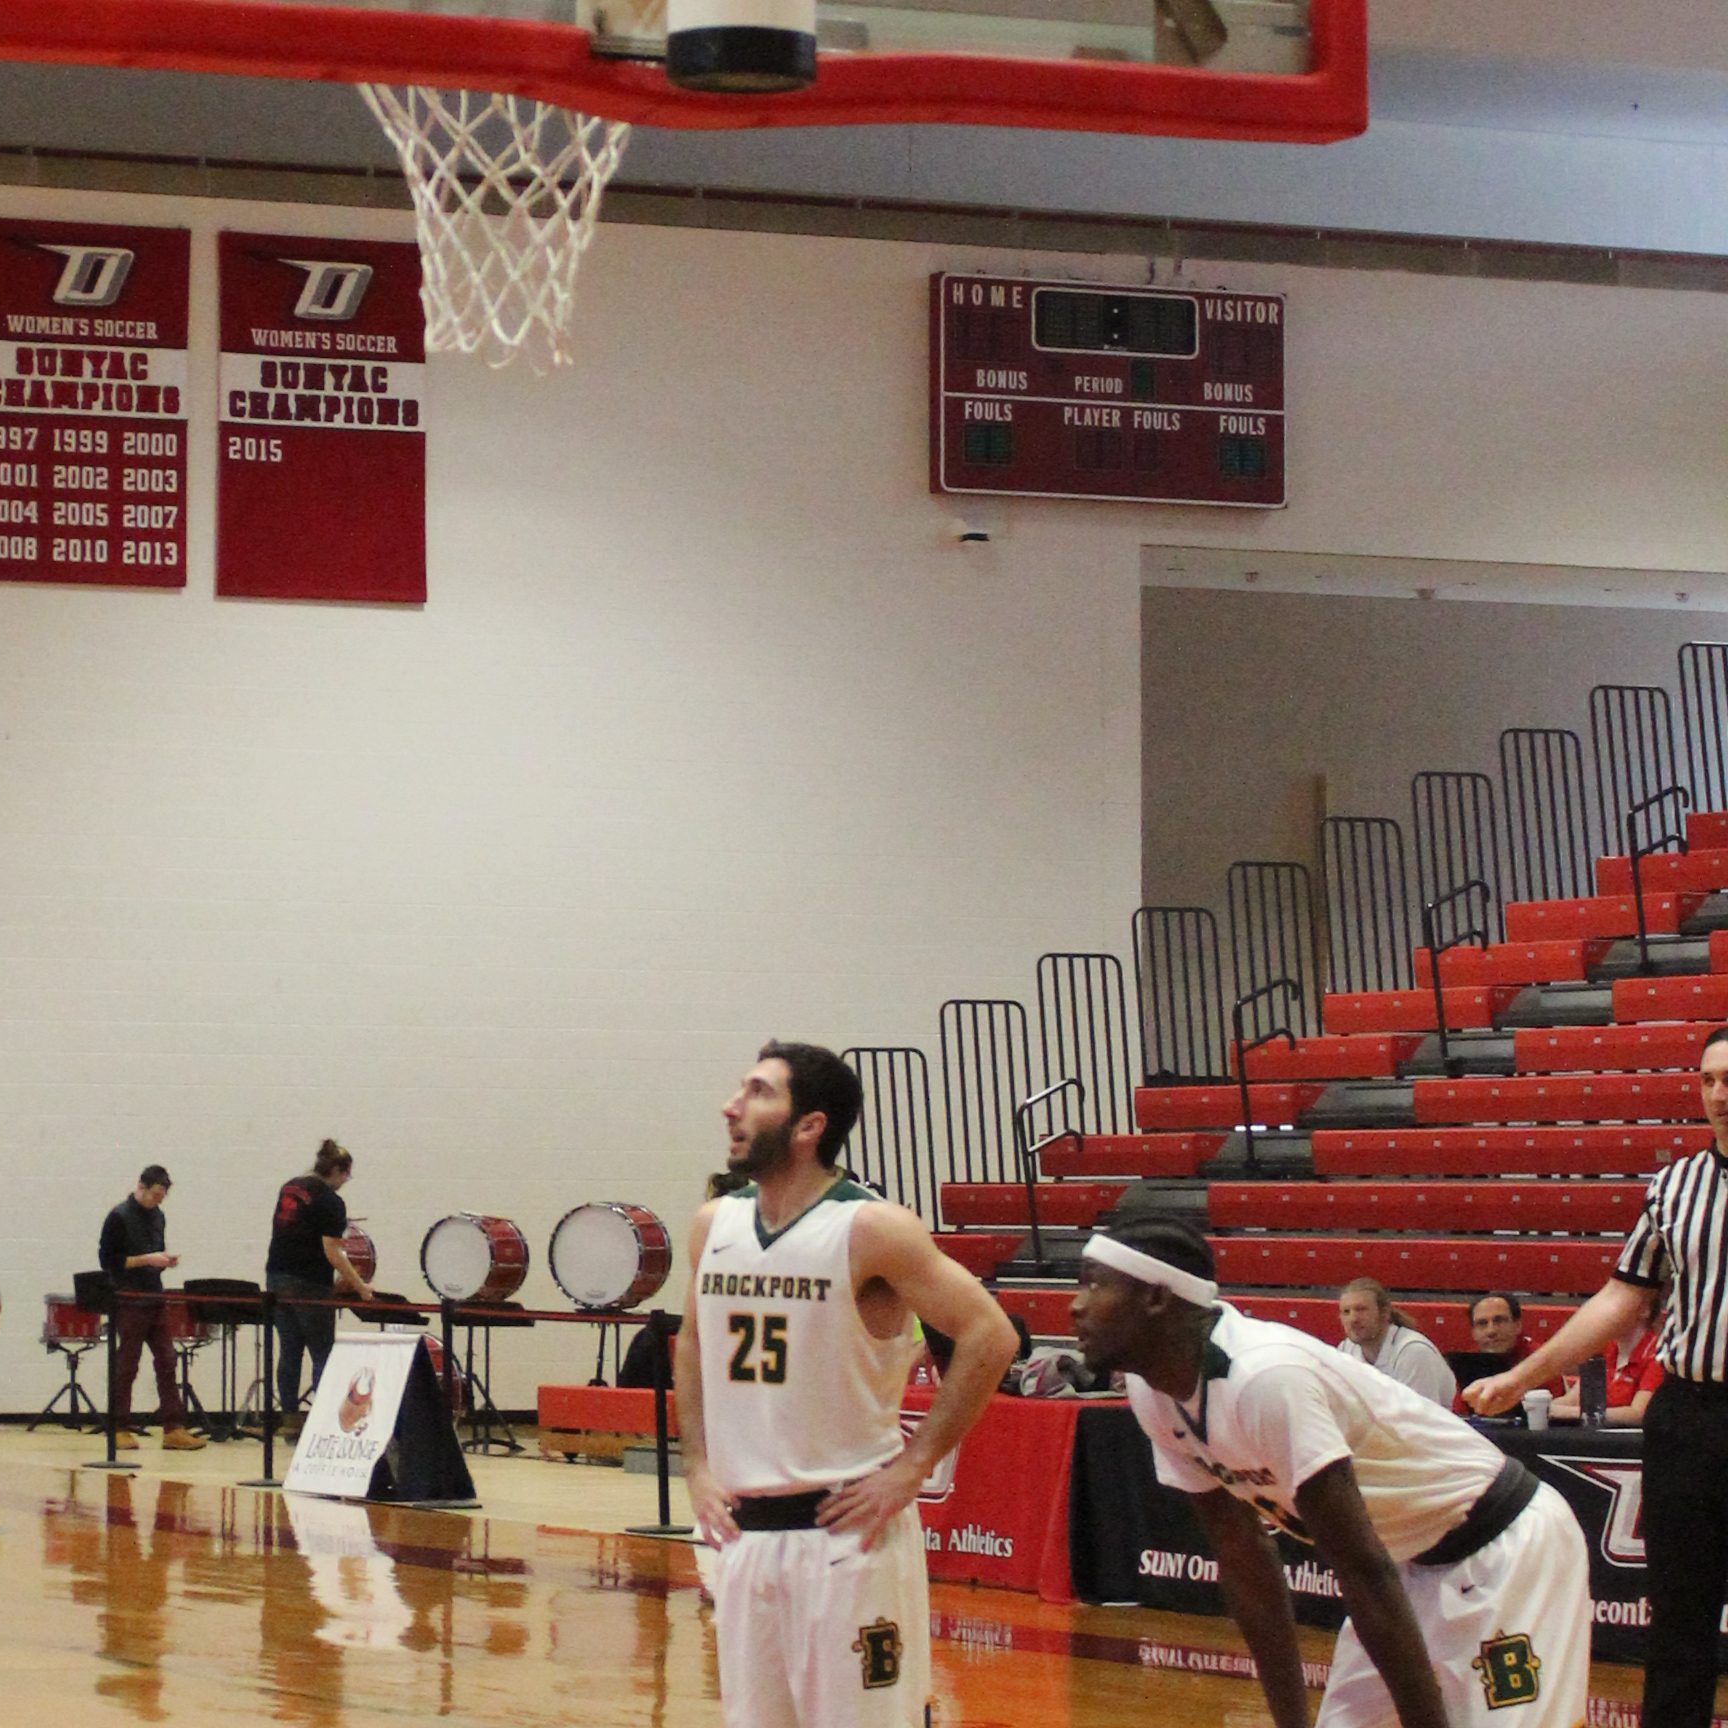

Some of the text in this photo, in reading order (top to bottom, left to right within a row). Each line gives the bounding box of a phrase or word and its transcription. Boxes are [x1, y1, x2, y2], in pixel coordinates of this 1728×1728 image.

[952, 282, 1279, 326] HOME VISITOR
[6, 313, 158, 341] WOMEN'S SOCCER
[251, 327, 398, 354] WOMEN'S SOCCER
[15, 346, 148, 381] SUNYAC
[260, 360, 388, 394] SUNYAC
[976, 369, 1254, 404] BONUS PERIOD BONUS
[228, 389, 420, 427] CHAMPIONS
[965, 402, 1266, 436] FOULS PLAYER FOULS FOULS
[53, 427, 109, 453] 1999
[122, 430, 178, 457] 2000
[228, 436, 283, 463] 2015
[53, 465, 109, 491] 2002
[122, 468, 178, 494] 2003
[53, 500, 109, 527] 2005
[122, 503, 178, 530] 2007
[53, 537, 109, 563] 2010
[122, 539, 178, 566] 2013
[701, 1271, 833, 1303] BROCKPORT
[728, 1312, 789, 1386] 25
[948, 1523, 1013, 1558] Athletics
[1138, 1549, 1185, 1579] SUNY
